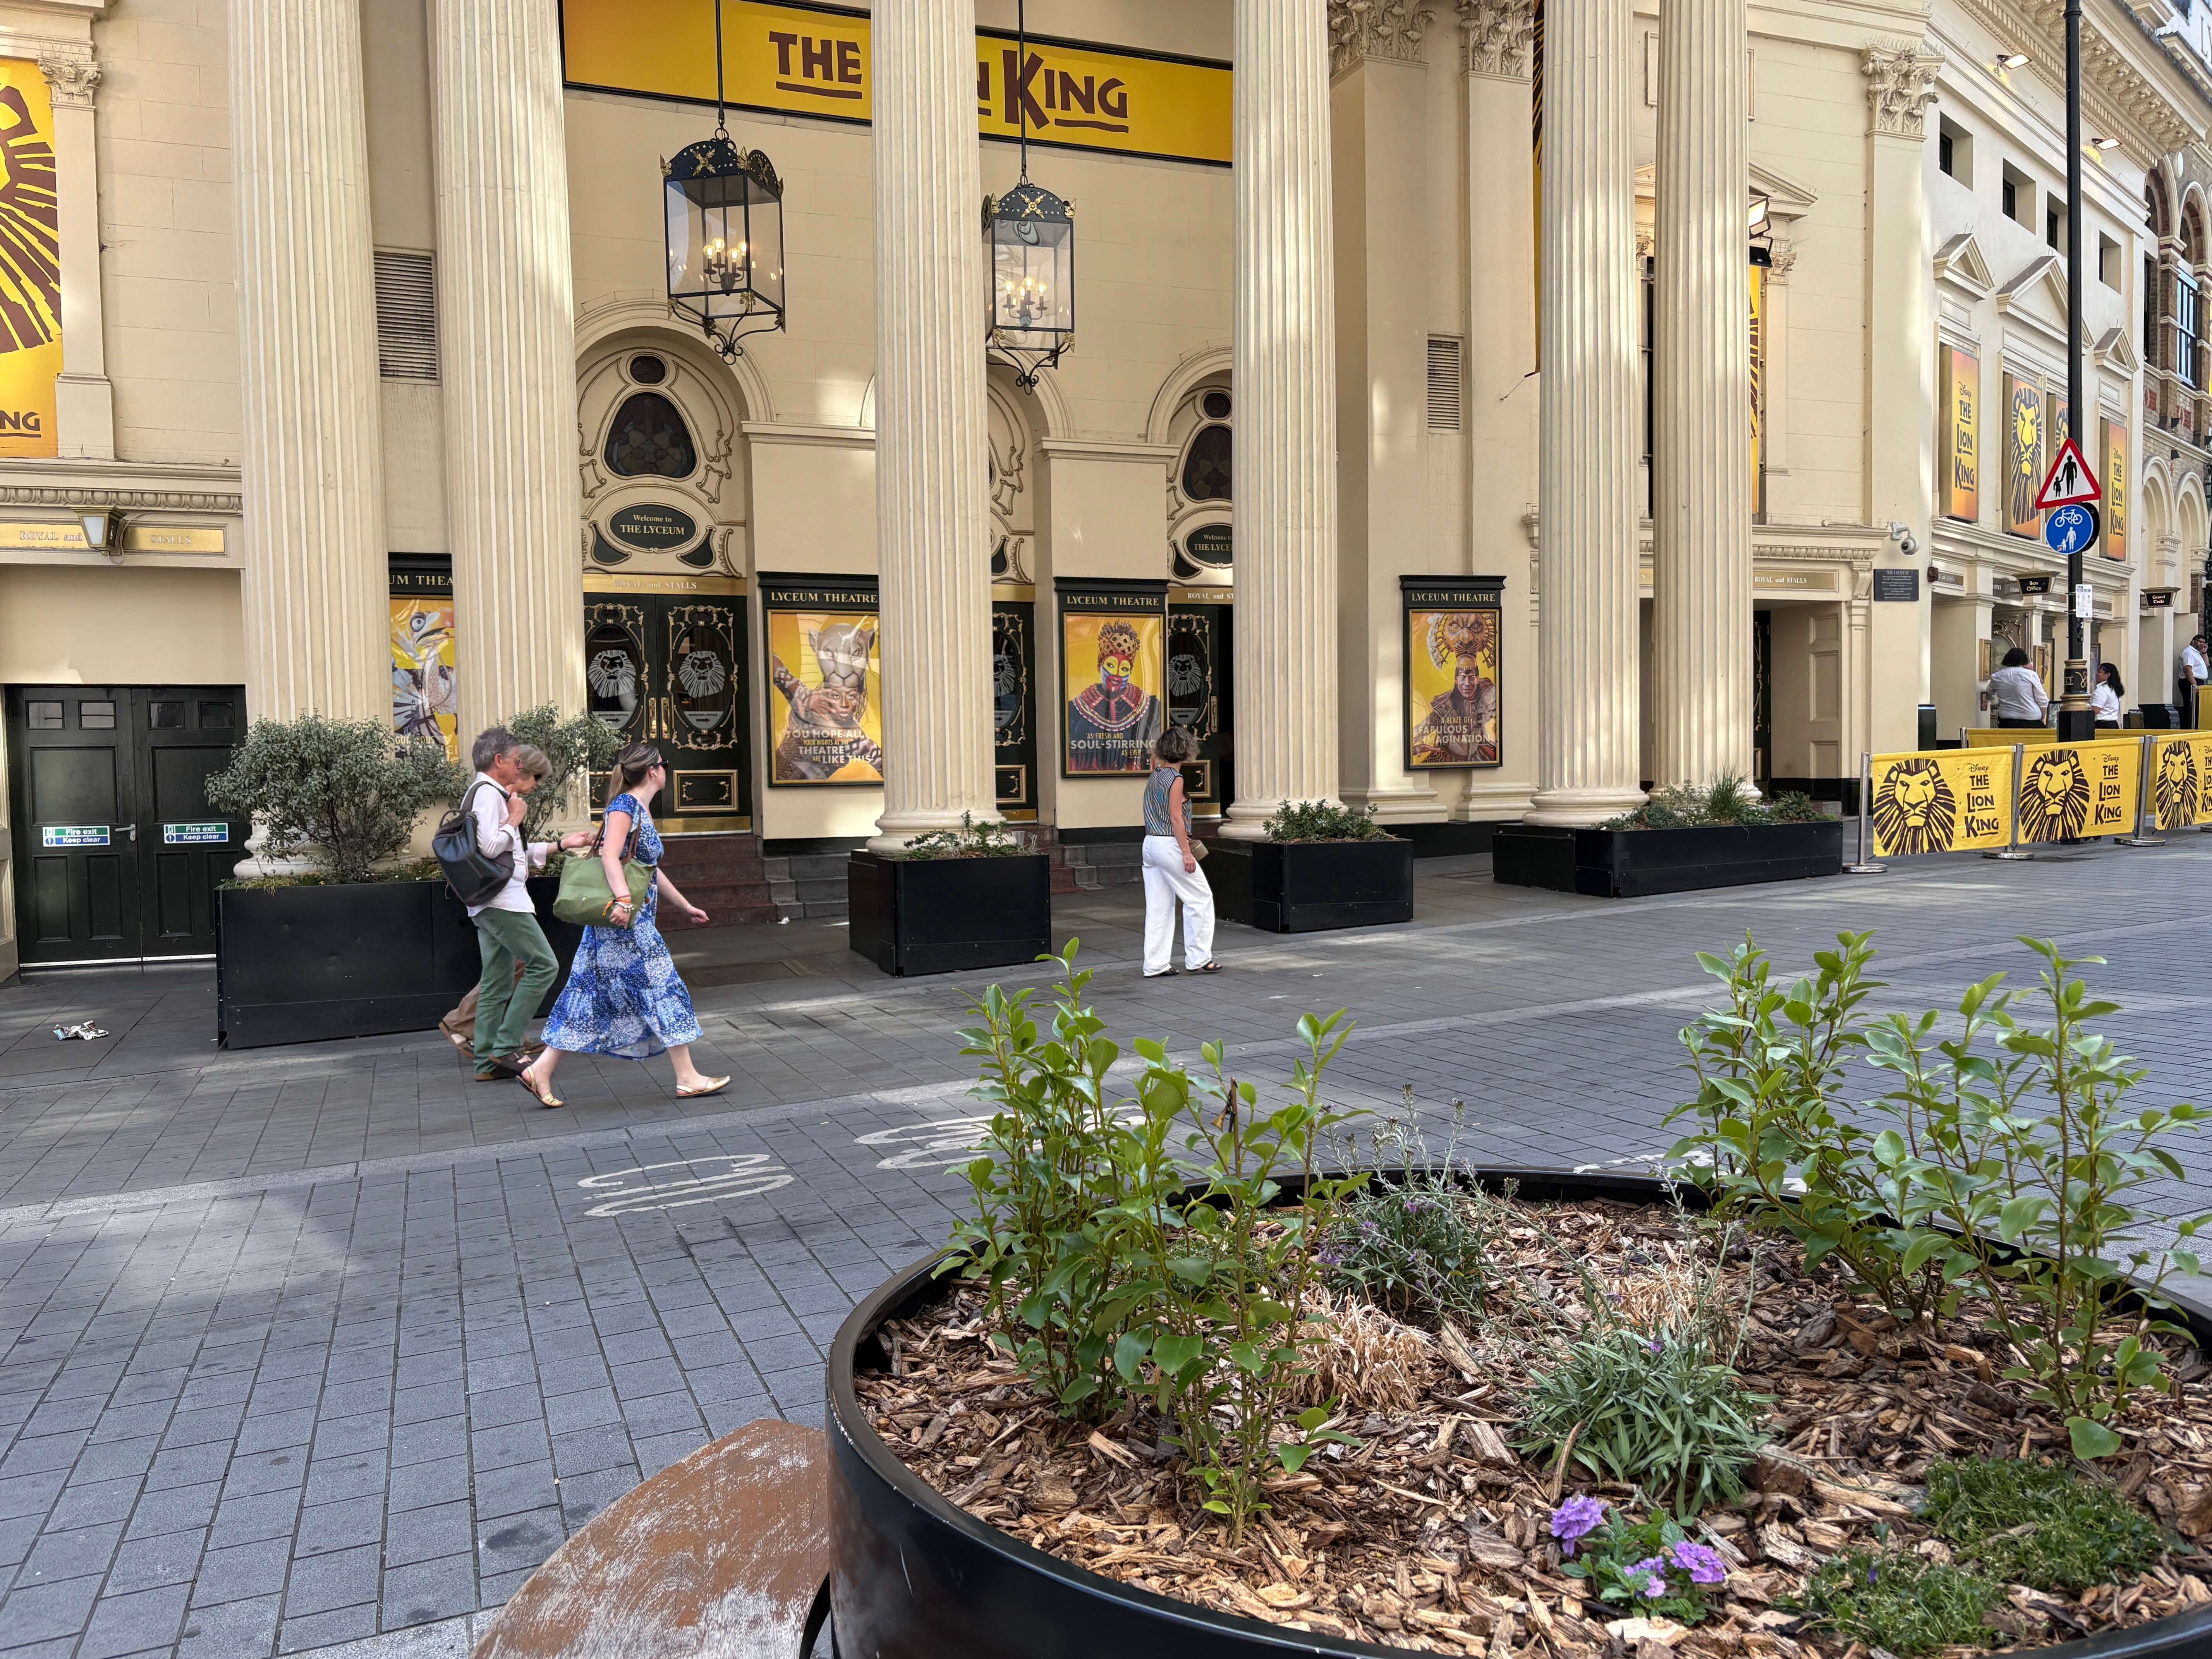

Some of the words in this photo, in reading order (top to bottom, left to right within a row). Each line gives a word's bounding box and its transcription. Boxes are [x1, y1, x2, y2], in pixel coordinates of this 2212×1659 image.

[769, 31, 862, 84] THE
[1003, 50, 1127, 130] KING
[1960, 400, 1971, 419] THE
[1957, 424, 1973, 453] LION
[1955, 456, 1974, 490] KING
[2112, 482, 2123, 506] LION
[2111, 508, 2124, 535] KING
[620, 525, 641, 533] THE
[644, 525, 685, 535] LYCEUM
[20, 531, 59, 541] ROYAL
[64, 533, 82, 541] and
[150, 535, 192, 544] STALLS
[416, 575, 453, 585] THEA
[771, 592, 818, 601] LYCEUM
[824, 593, 878, 603] THEATRE
[1067, 596, 1107, 605] LYCEUM
[1112, 597, 1159, 606] THEATRE
[787, 730, 809, 738] YOU
[813, 730, 843, 738] HOPE
[846, 730, 864, 738] ALL
[1419, 725, 1468, 733] FABULOUS
[799, 746, 845, 755] THEATRE
[1070, 740, 1156, 749] SOUL-STIRRING
[823, 756, 845, 764] LIKE
[2102, 754, 2119, 763] Disney
[1967, 763, 1989, 773] Disney
[2103, 764, 2118, 776] THE
[1969, 774, 1989, 787] THE
[2099, 782, 2120, 801] LION
[1967, 793, 1994, 813] LION
[2094, 804, 2121, 825] KING
[1964, 815, 1999, 838] KING
